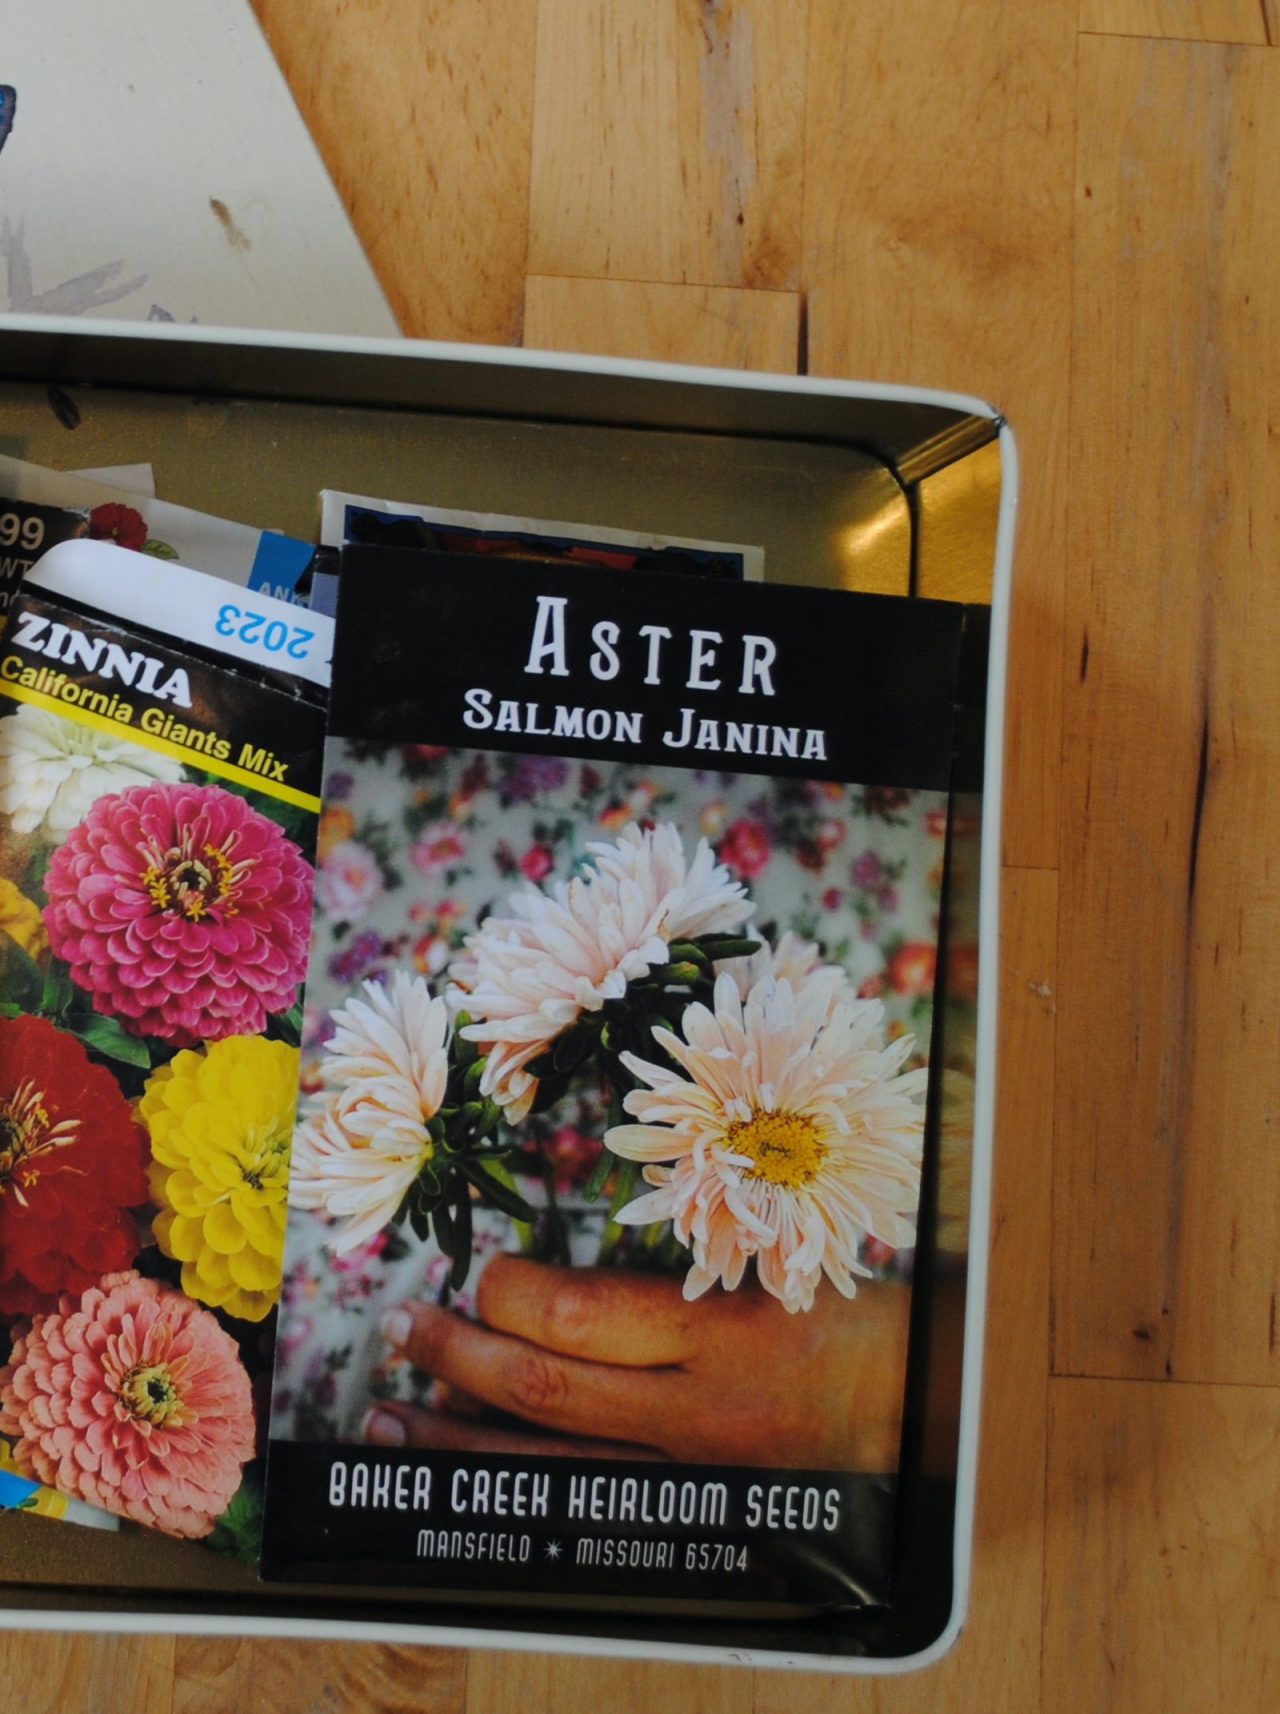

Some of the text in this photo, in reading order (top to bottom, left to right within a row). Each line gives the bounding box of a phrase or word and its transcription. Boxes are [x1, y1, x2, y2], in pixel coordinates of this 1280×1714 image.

[12, 612, 192, 708] ZINNIA
[215, 604, 315, 659] 2023
[0, 655, 289, 782] California Giants Mix
[329, 1462, 840, 1531] BAKER CREEK HEIRLOOM SEEDS
[417, 1530, 747, 1571] MANSFIELD MISSOURI 65704
